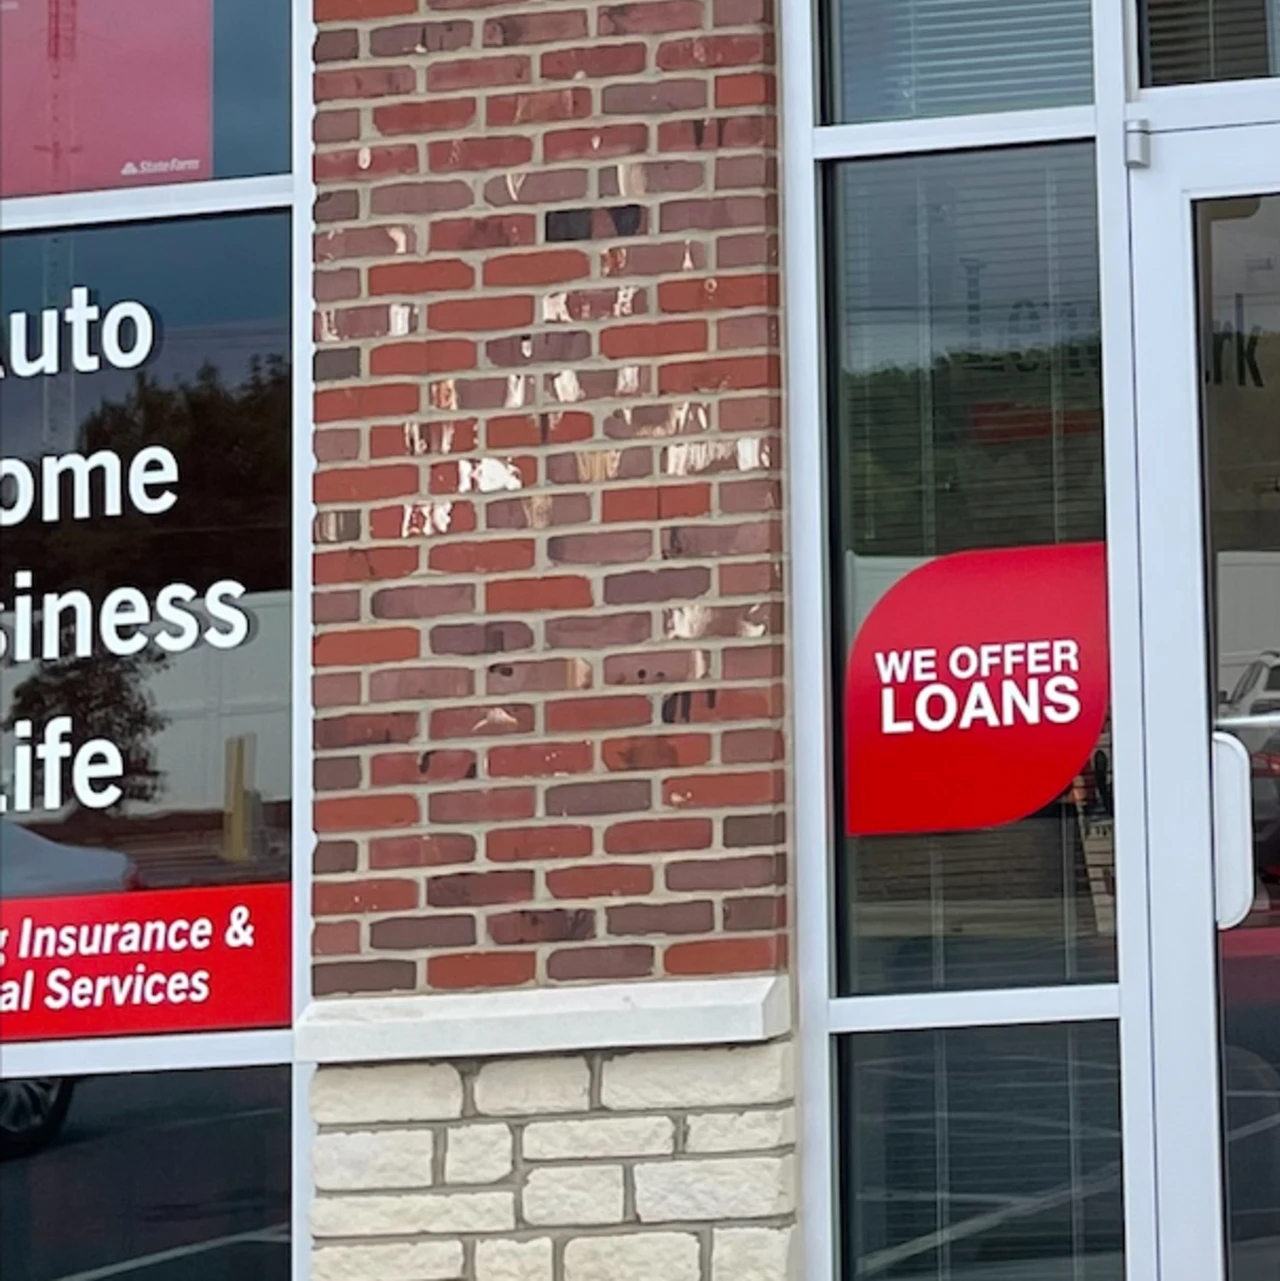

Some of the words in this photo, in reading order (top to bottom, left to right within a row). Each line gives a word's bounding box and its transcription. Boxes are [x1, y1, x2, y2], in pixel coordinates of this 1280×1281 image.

[0, 286, 153, 378] uto
[0, 570, 248, 661] iness
[875, 648, 937, 684] WE
[949, 639, 1079, 680] OFFER
[881, 675, 1081, 734] LOANS
[0, 716, 123, 812] ife
[18, 917, 213, 959] Insurance
[225, 905, 255, 948] &
[0, 970, 34, 1011] al
[44, 963, 210, 1010] Services
